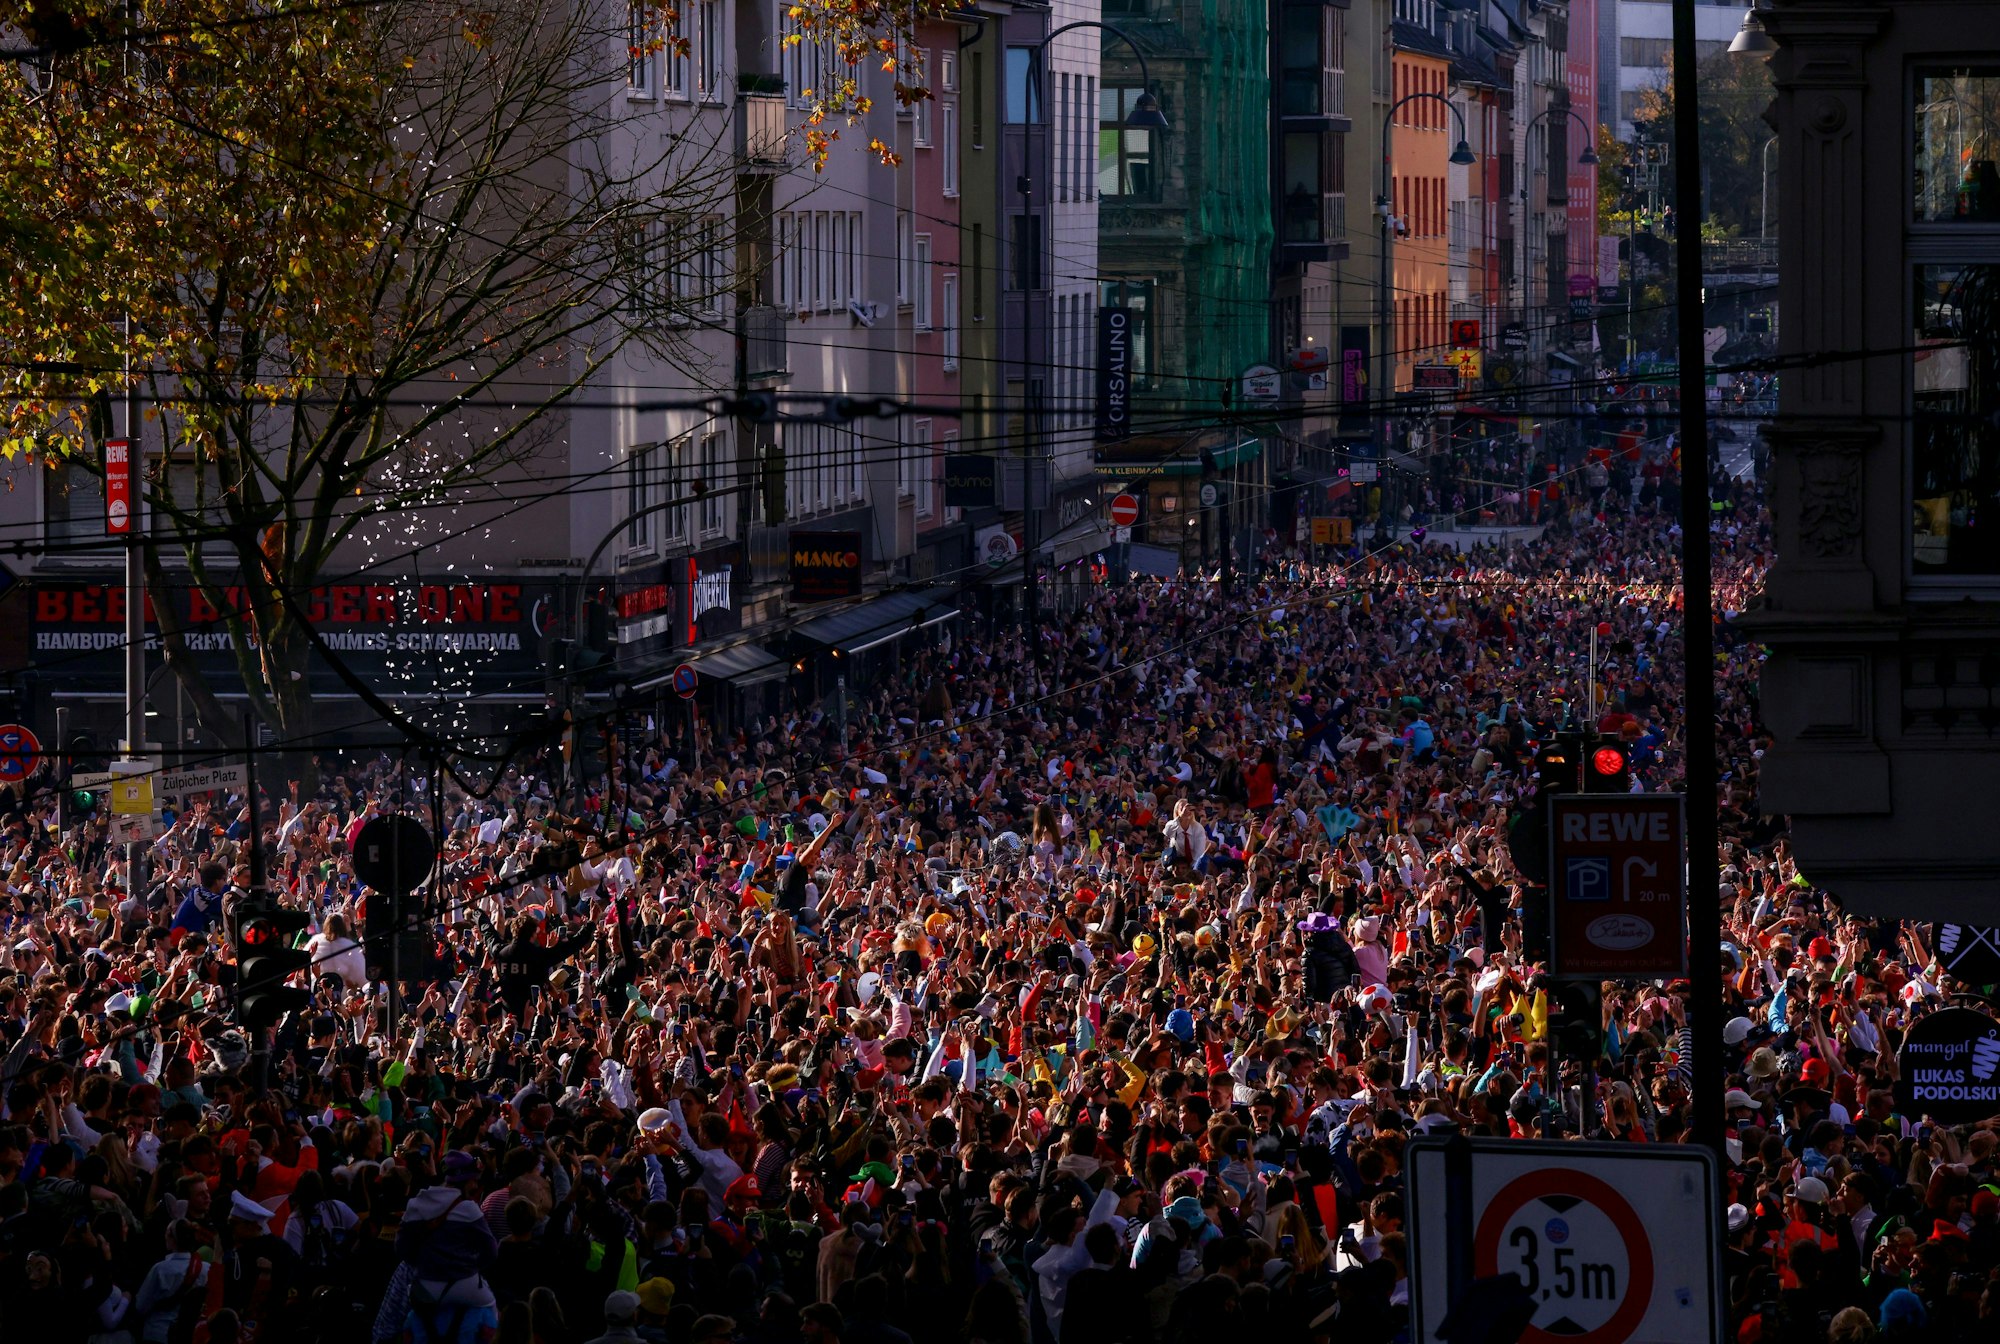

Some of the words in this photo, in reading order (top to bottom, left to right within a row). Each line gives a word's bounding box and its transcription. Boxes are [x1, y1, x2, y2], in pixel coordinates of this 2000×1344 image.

[106, 445, 128, 463] REWE
[793, 549, 859, 568] MANGO
[419, 584, 523, 623] ONE
[162, 772, 209, 792] Zülpicher
[212, 770, 238, 784] Platz
[1562, 812, 1671, 842] REWE
[1579, 868, 1600, 897] P
[1639, 890, 1654, 902] 20
[1658, 892, 1671, 902] m
[500, 962, 527, 975] FBI
[1908, 1039, 1971, 1061] mangal
[1914, 1069, 1965, 1083] LUKAS
[1914, 1086, 1997, 1100] PODOLSKI
